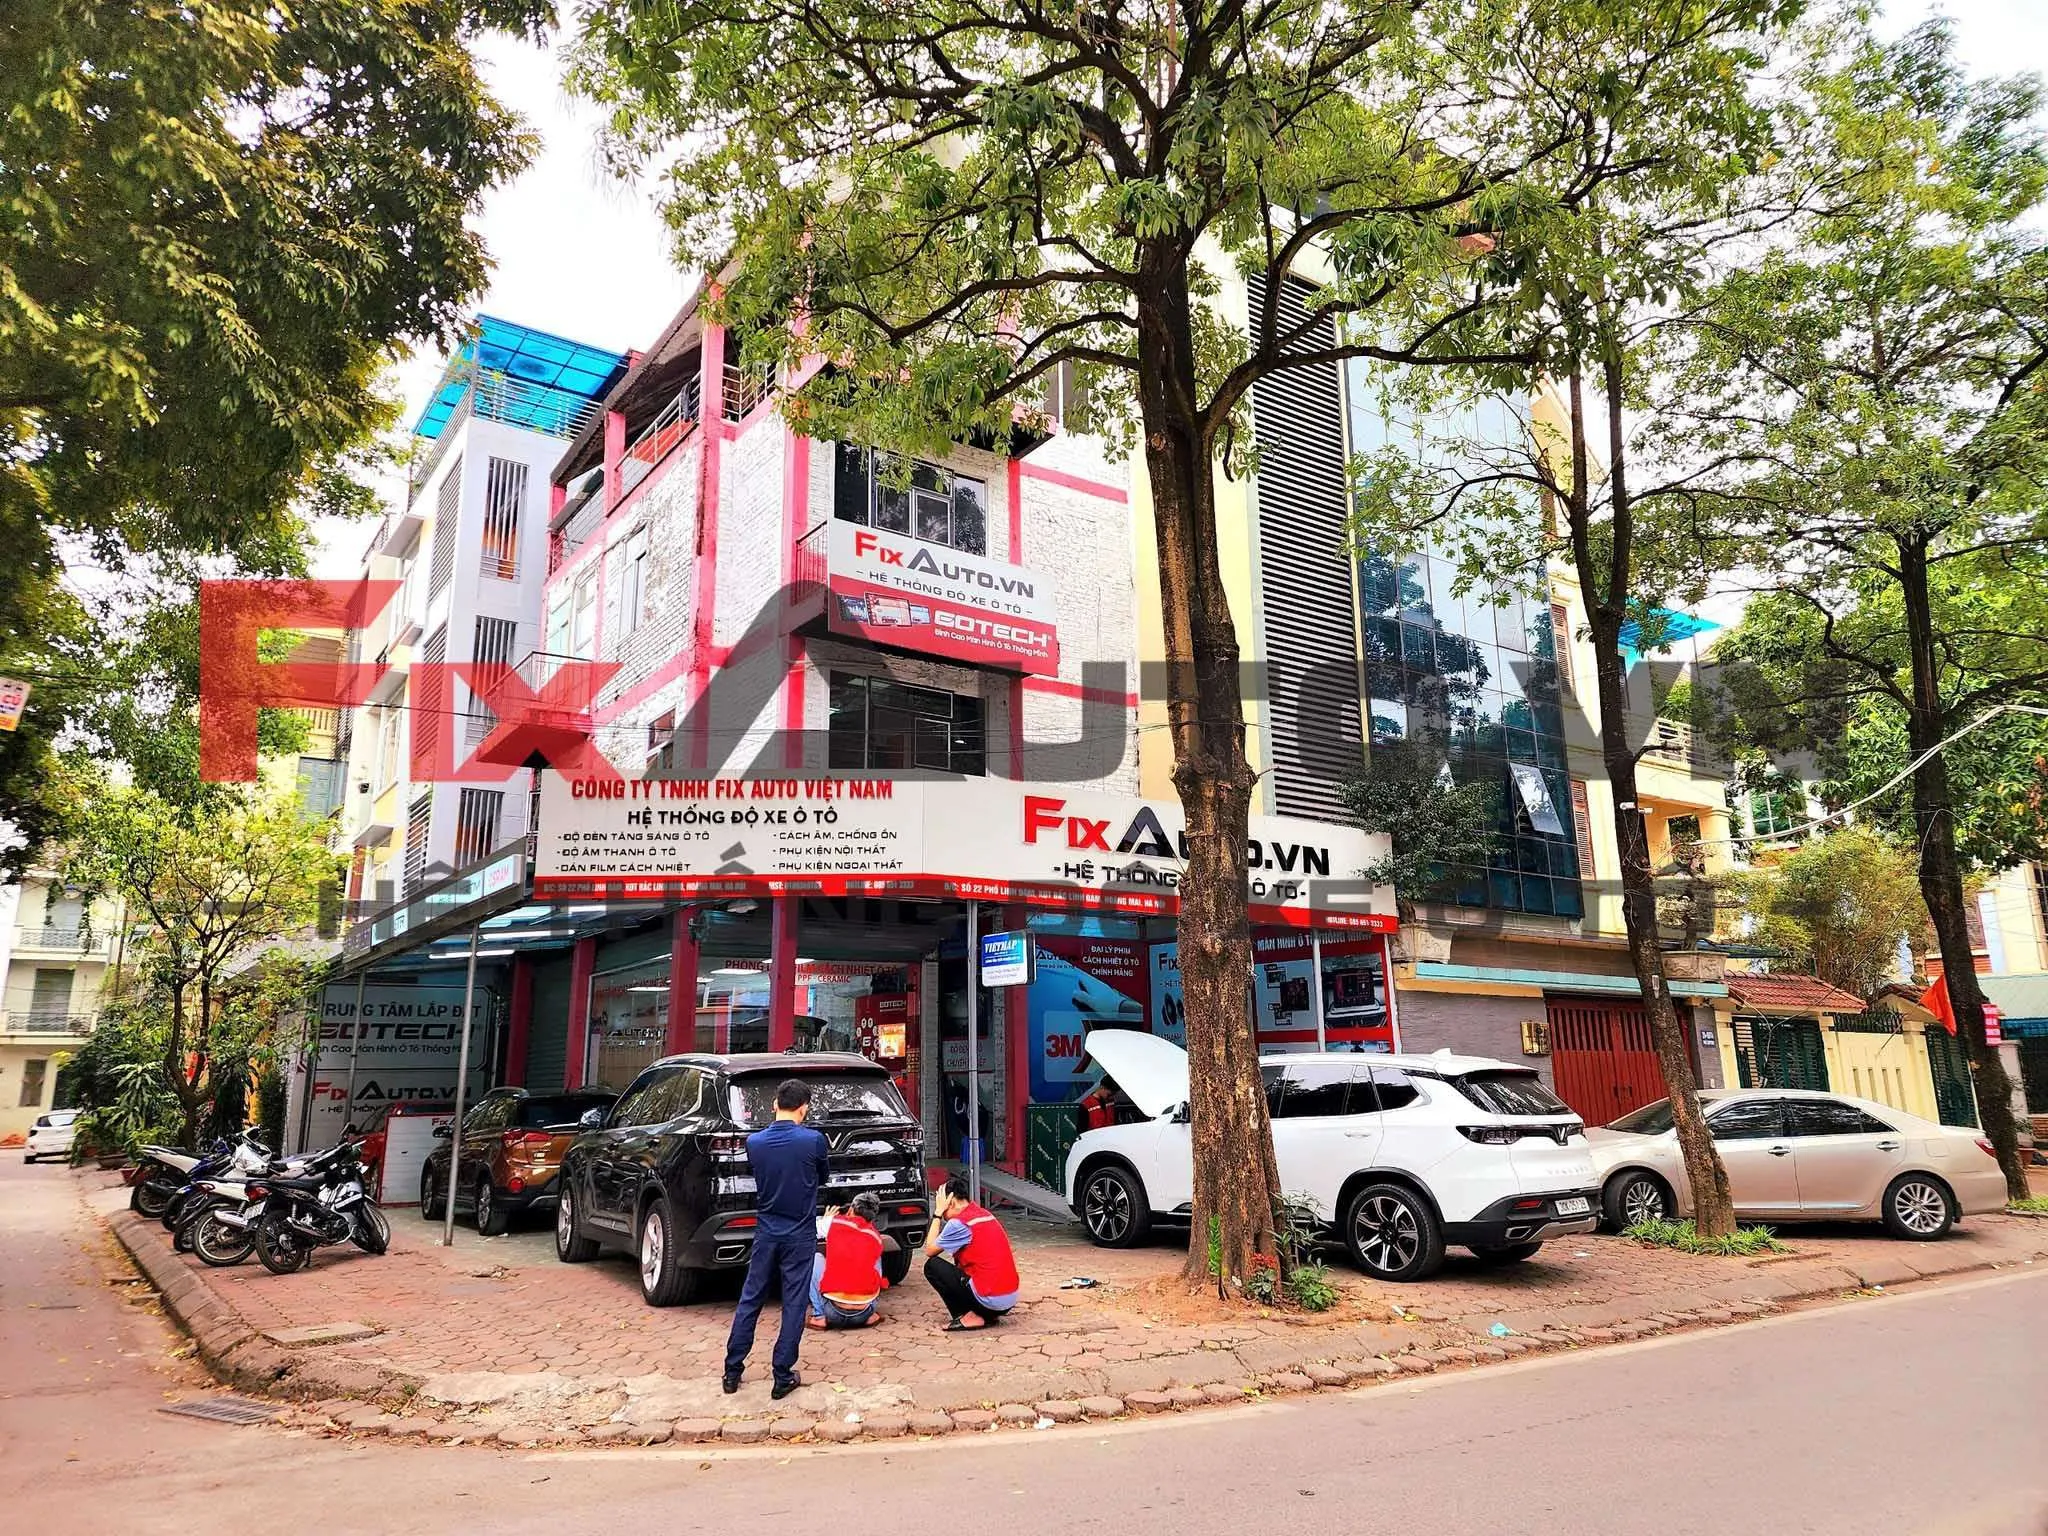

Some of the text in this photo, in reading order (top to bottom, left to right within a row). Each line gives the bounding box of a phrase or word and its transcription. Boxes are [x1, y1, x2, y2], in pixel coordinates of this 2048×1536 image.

[571, 775, 893, 803] CÔNG TY TNHH FIX AUTO VIỆT NAM
[628, 803, 838, 829] HỆ THỐNG ĐỘ XE Ô TÔ
[590, 864, 616, 872] FILM
[620, 861, 653, 872] CÁCH
[972, 884, 982, 894] 22
[1252, 877, 1265, 896] Ô
[818, 975, 850, 983] CERAMIC
[380, 1002, 412, 1017] TÂM
[1046, 1034, 1082, 1058] 3M
